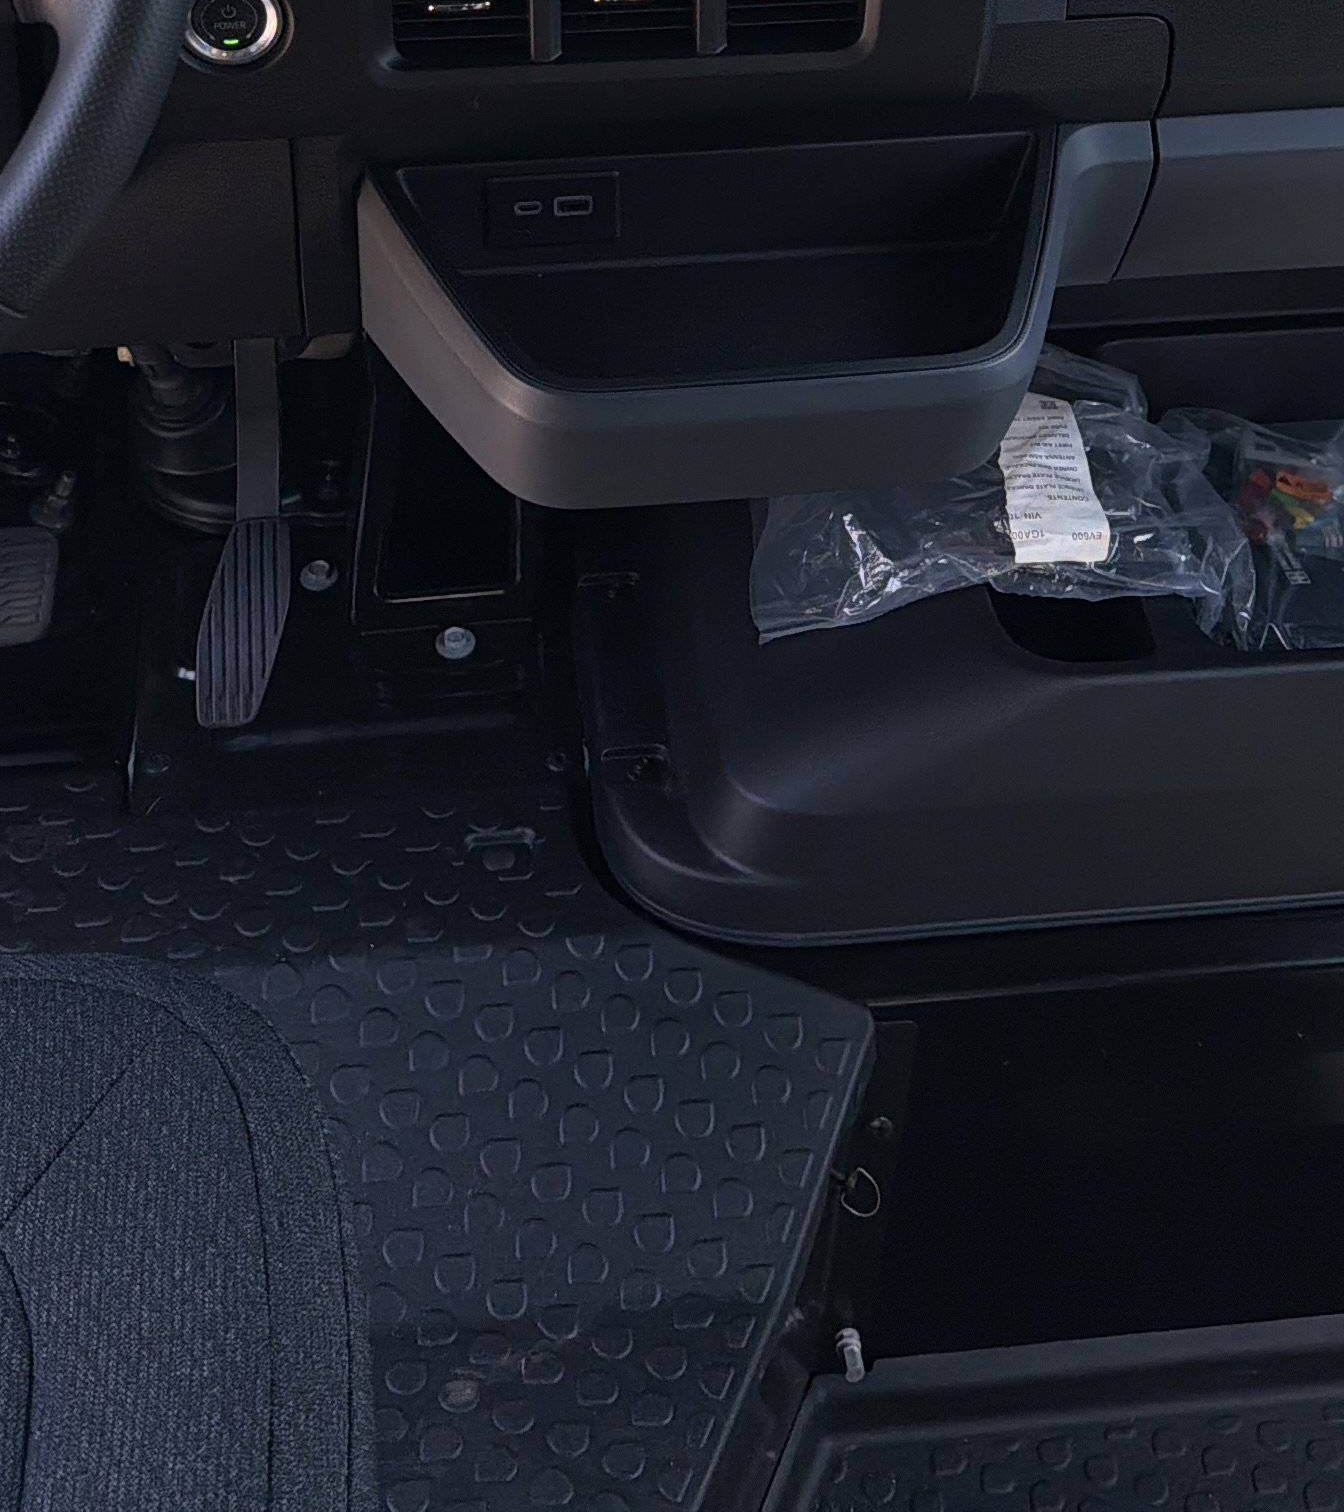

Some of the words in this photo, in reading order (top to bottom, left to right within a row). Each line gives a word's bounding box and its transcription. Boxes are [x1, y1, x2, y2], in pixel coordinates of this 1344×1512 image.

[213, 21, 247, 30] POWER
[1023, 511, 1042, 520] VIN
[1071, 531, 1103, 541] EV600
